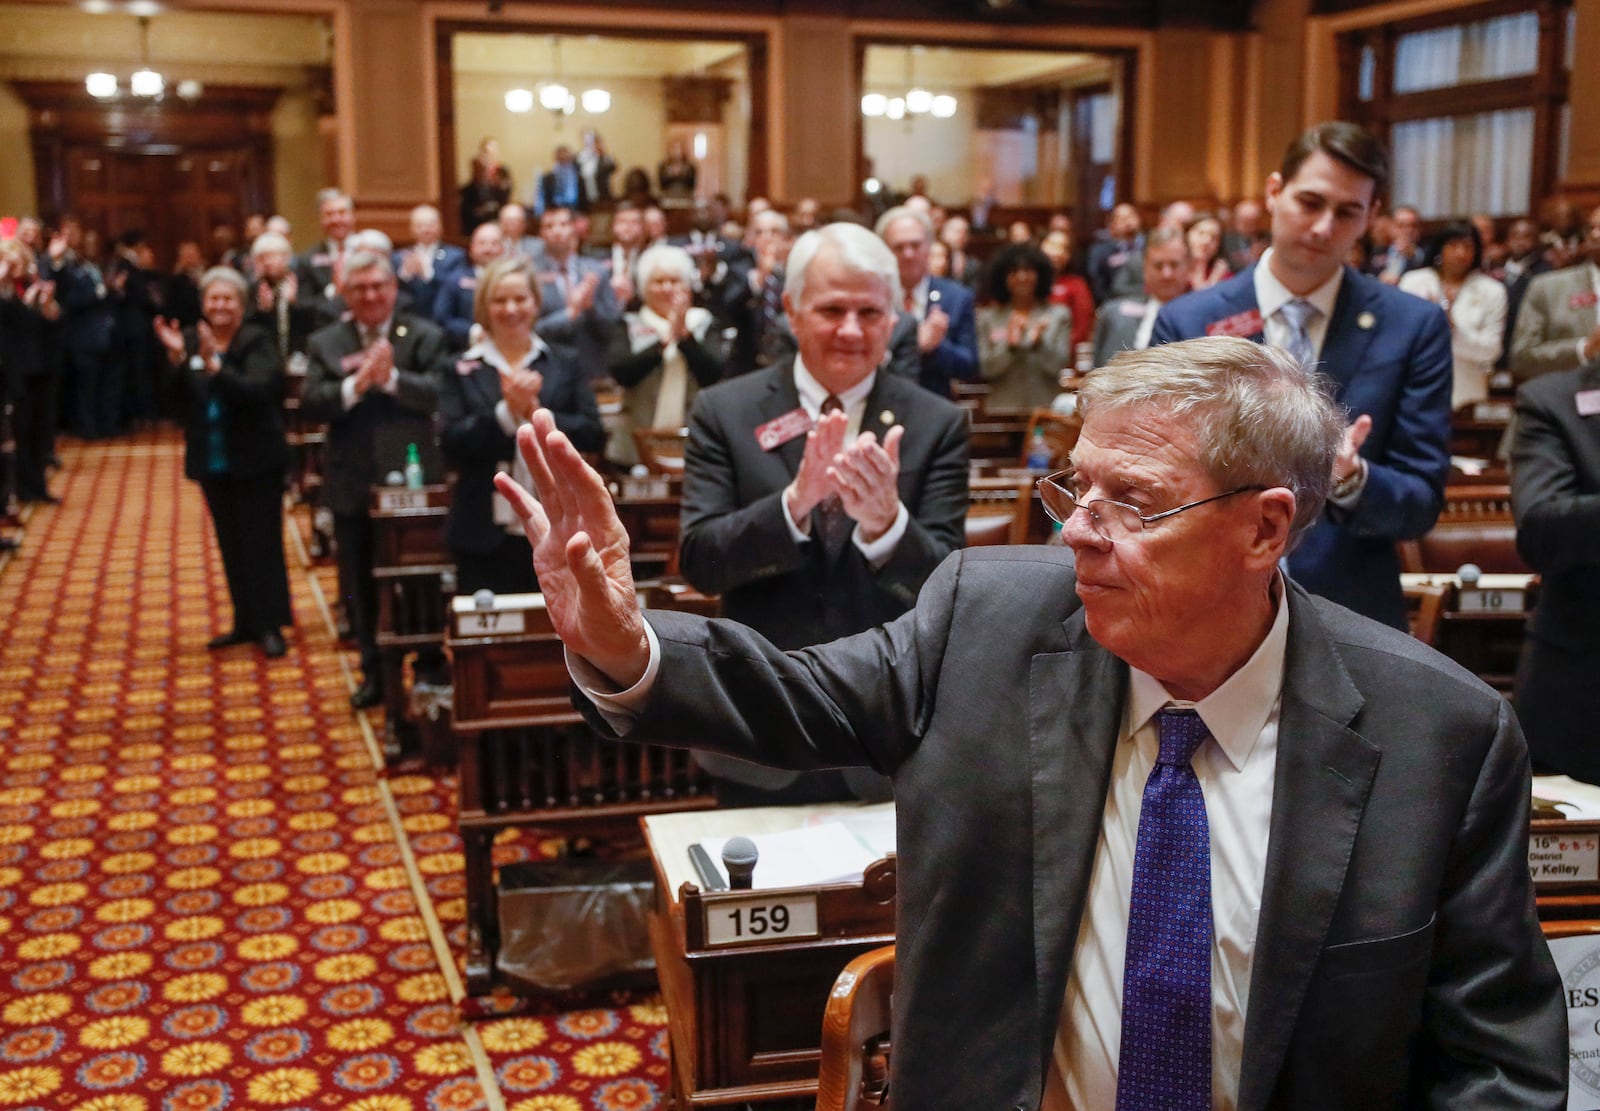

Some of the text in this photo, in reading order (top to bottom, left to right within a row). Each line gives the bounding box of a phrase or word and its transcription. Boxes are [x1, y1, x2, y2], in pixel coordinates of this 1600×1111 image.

[1529, 852, 1562, 861] District
[1542, 864, 1580, 876] Kelley
[728, 904, 790, 936] 159
